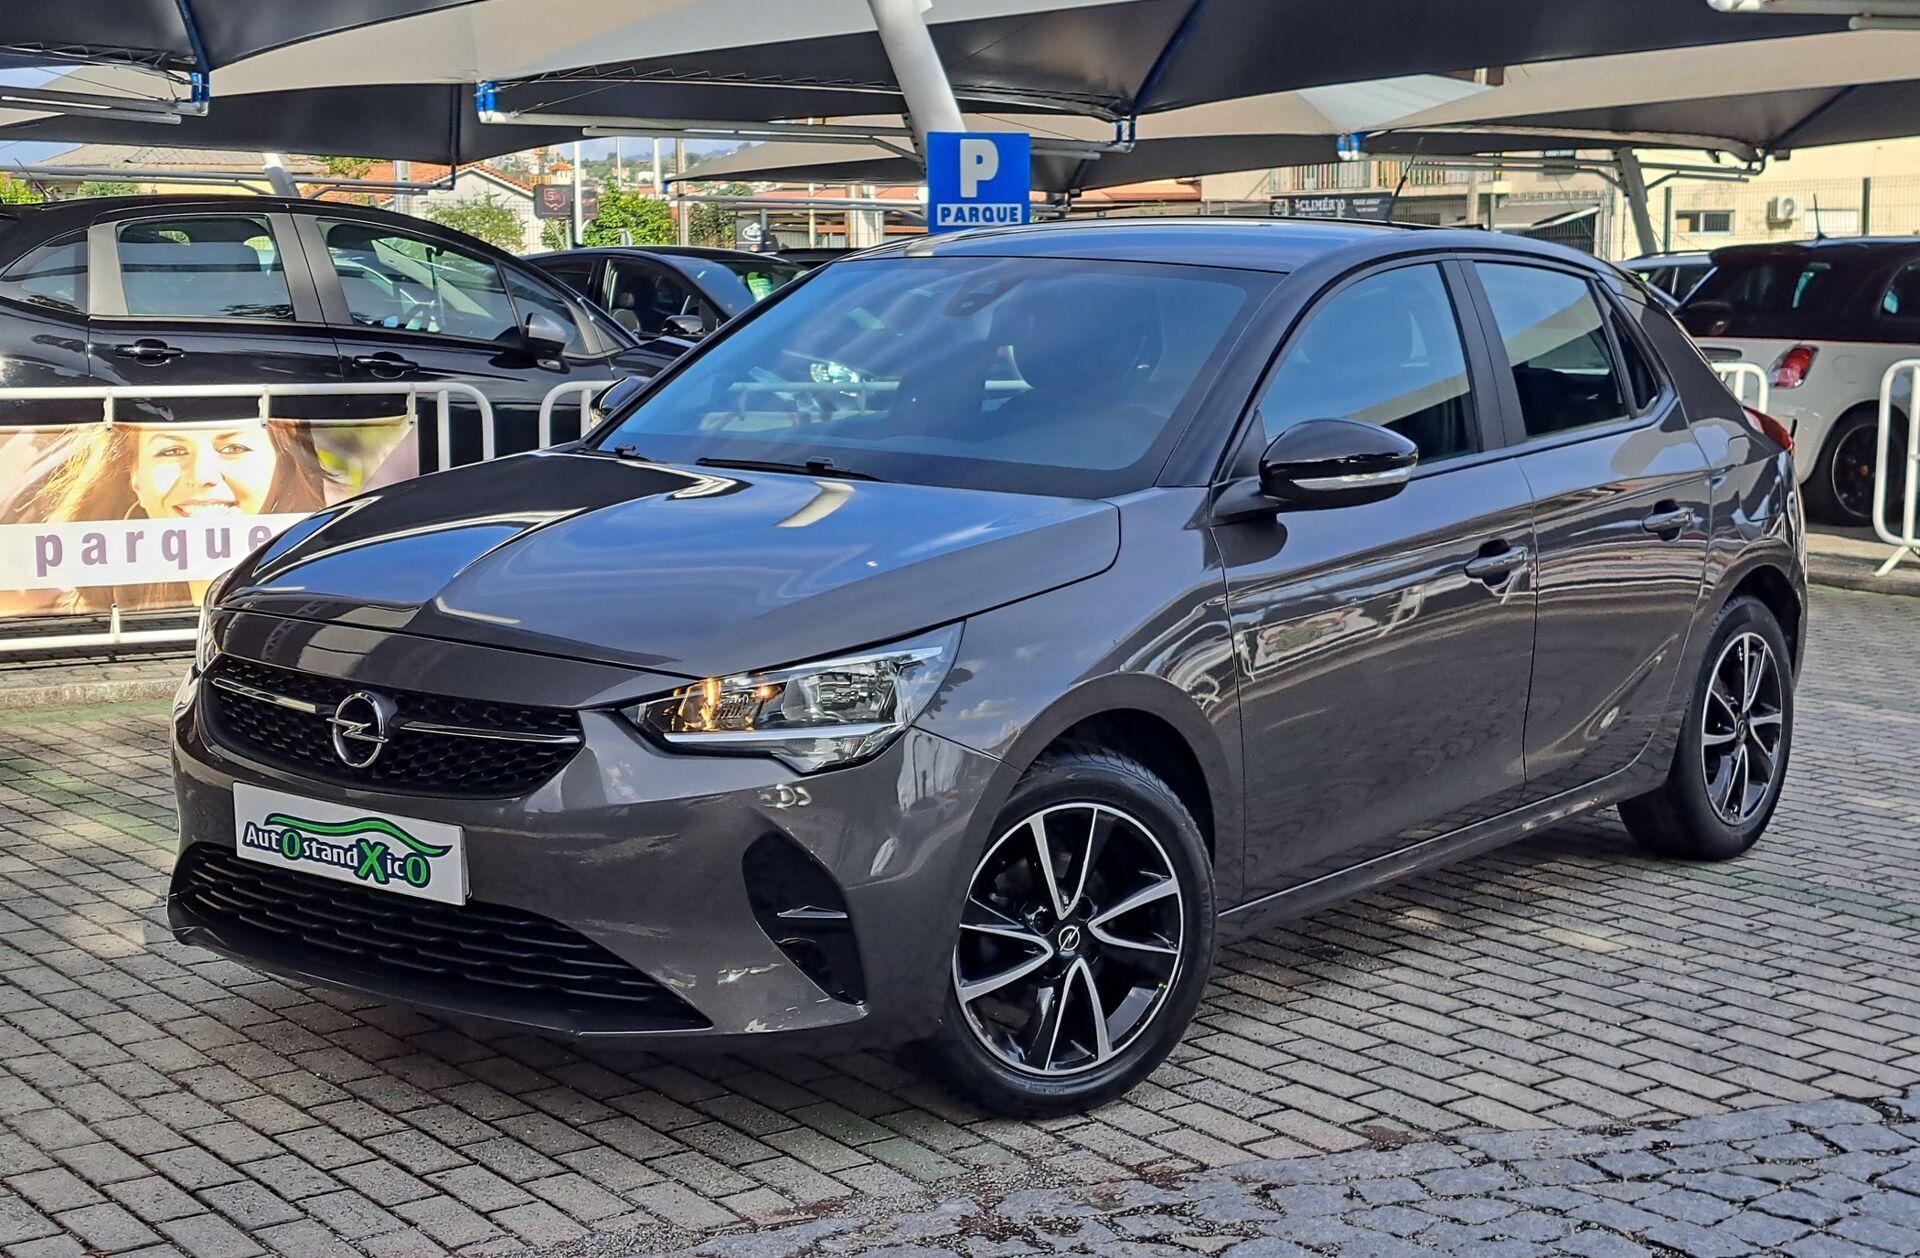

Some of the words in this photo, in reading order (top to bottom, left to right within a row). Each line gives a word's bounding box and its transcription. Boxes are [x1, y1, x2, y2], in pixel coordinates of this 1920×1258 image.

[960, 138, 999, 198] P
[1299, 197, 1346, 212] CLIMÉRO
[940, 206, 1019, 223] PARQUE
